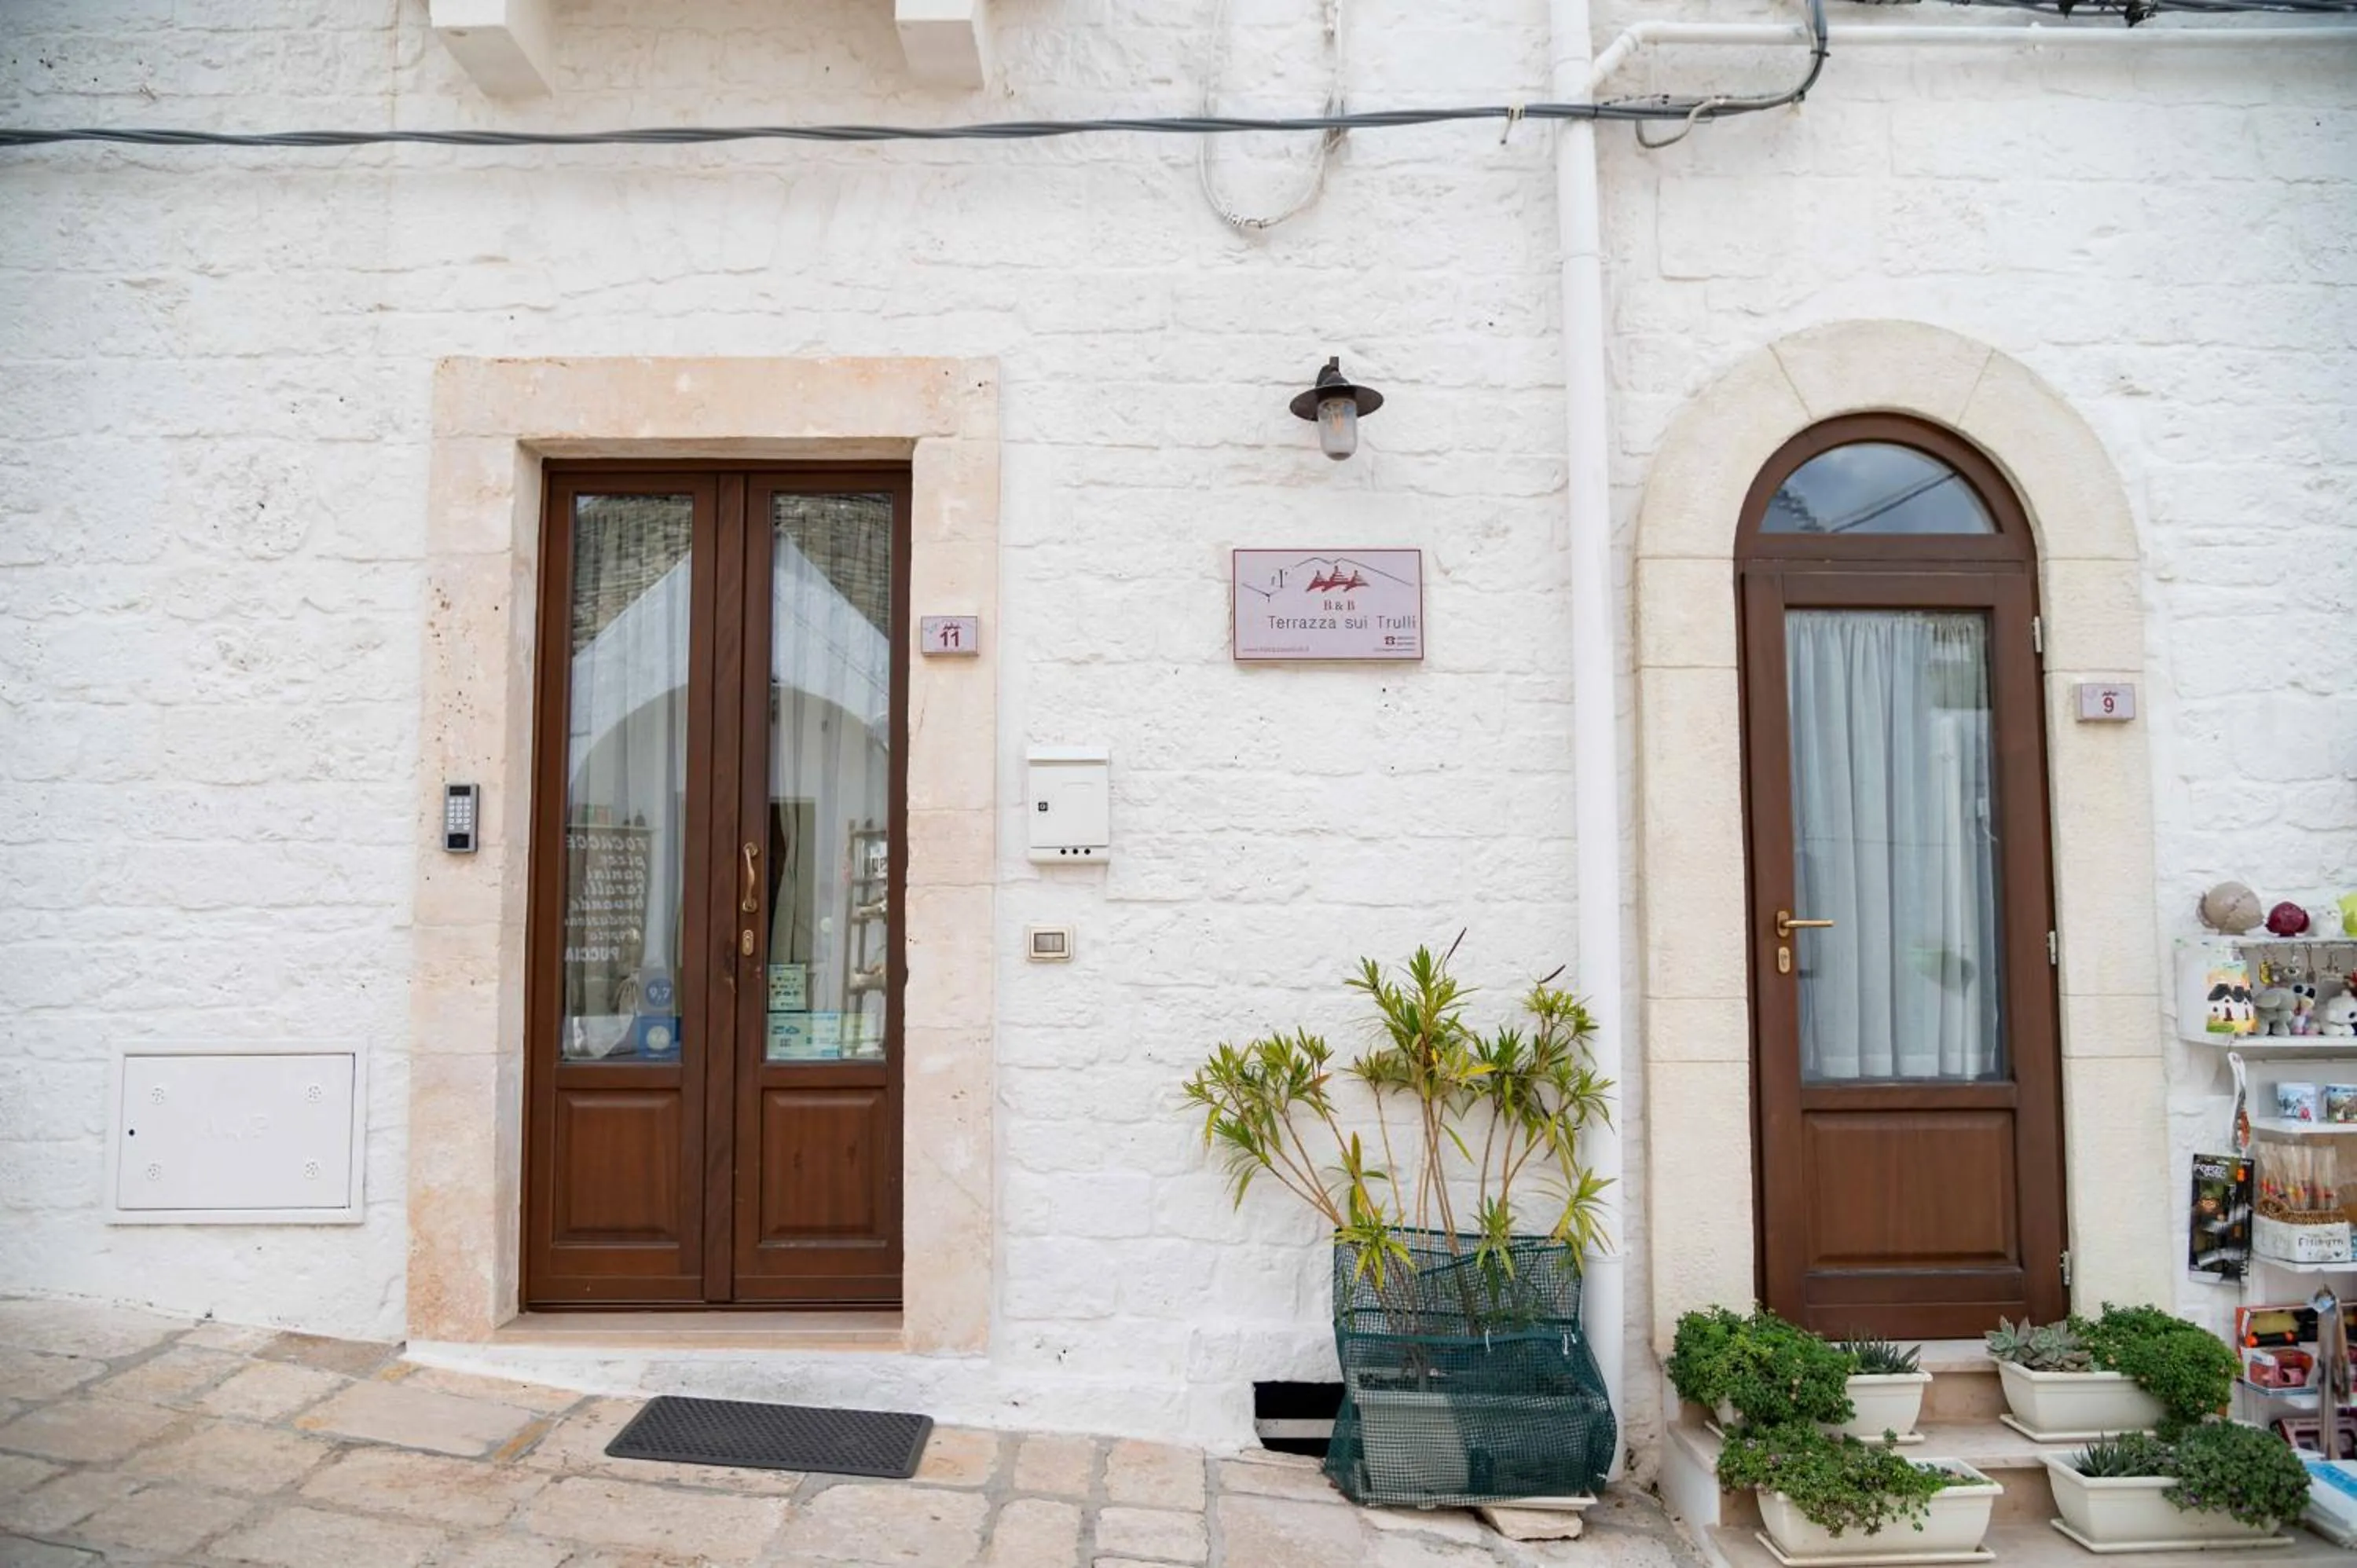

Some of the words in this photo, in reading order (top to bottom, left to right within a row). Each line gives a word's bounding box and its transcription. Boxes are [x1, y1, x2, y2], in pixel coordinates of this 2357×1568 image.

[1323, 600, 1332, 611] B
[1335, 602, 1343, 611] &
[1347, 600, 1356, 611] B
[1267, 615, 1336, 630] Terrazza
[1344, 616, 1368, 630] sui
[1376, 615, 1417, 630] Trulli
[940, 630, 959, 647] 11
[2102, 696, 2115, 714] 9
